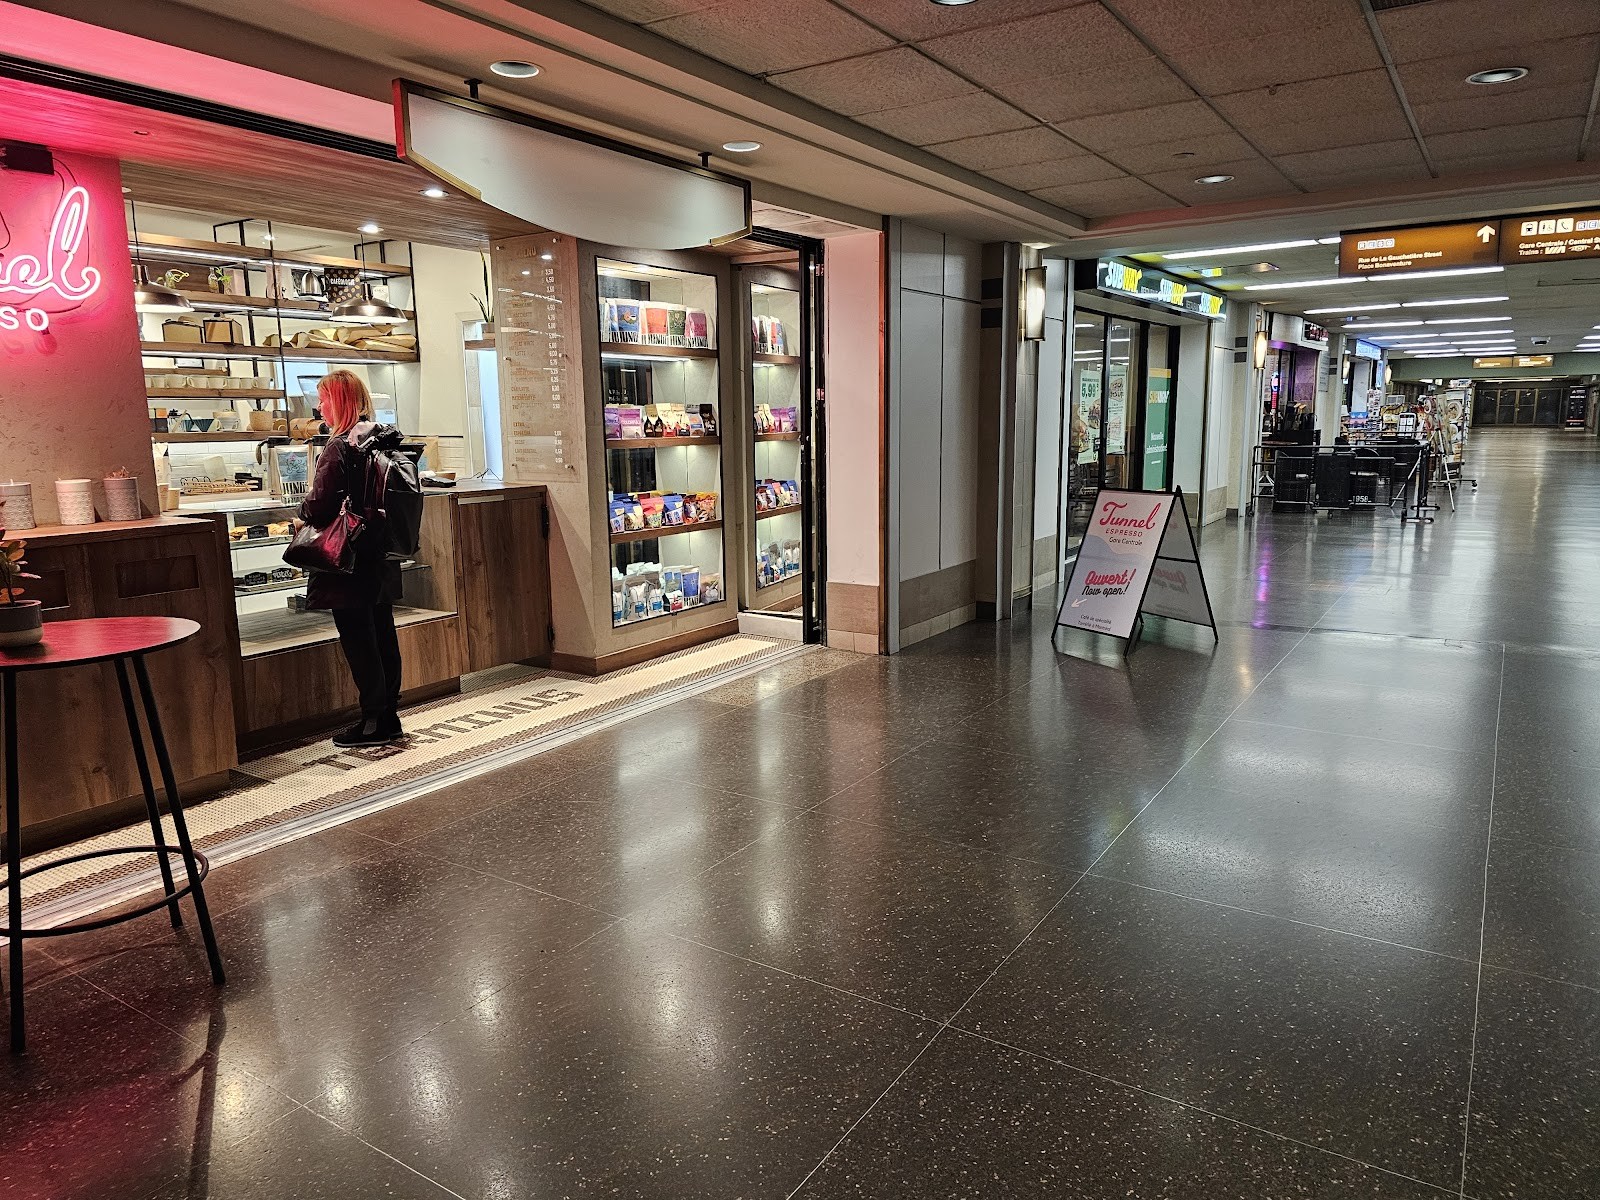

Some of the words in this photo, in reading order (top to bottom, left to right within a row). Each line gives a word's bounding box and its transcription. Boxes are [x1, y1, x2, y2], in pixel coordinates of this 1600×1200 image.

[1536, 239, 1564, 248] Centrale
[1568, 237, 1593, 245] Central
[1388, 253, 1423, 261] Gauchetière
[1423, 250, 1443, 258] Street
[1375, 260, 1412, 268] Bonaventure
[1105, 261, 1143, 294] SUBWAY
[1159, 278, 1188, 307] SUBWAY
[1199, 292, 1224, 315] SUBWAY
[1099, 501, 1162, 530] Tunnel
[1105, 528, 1143, 538] ESPRESSO
[1108, 536, 1121, 544] Gare
[1121, 538, 1143, 547] Centrale
[1084, 568, 1137, 586] Ouvert!
[1081, 585, 1102, 596] Now
[1102, 582, 1131, 598] open!
